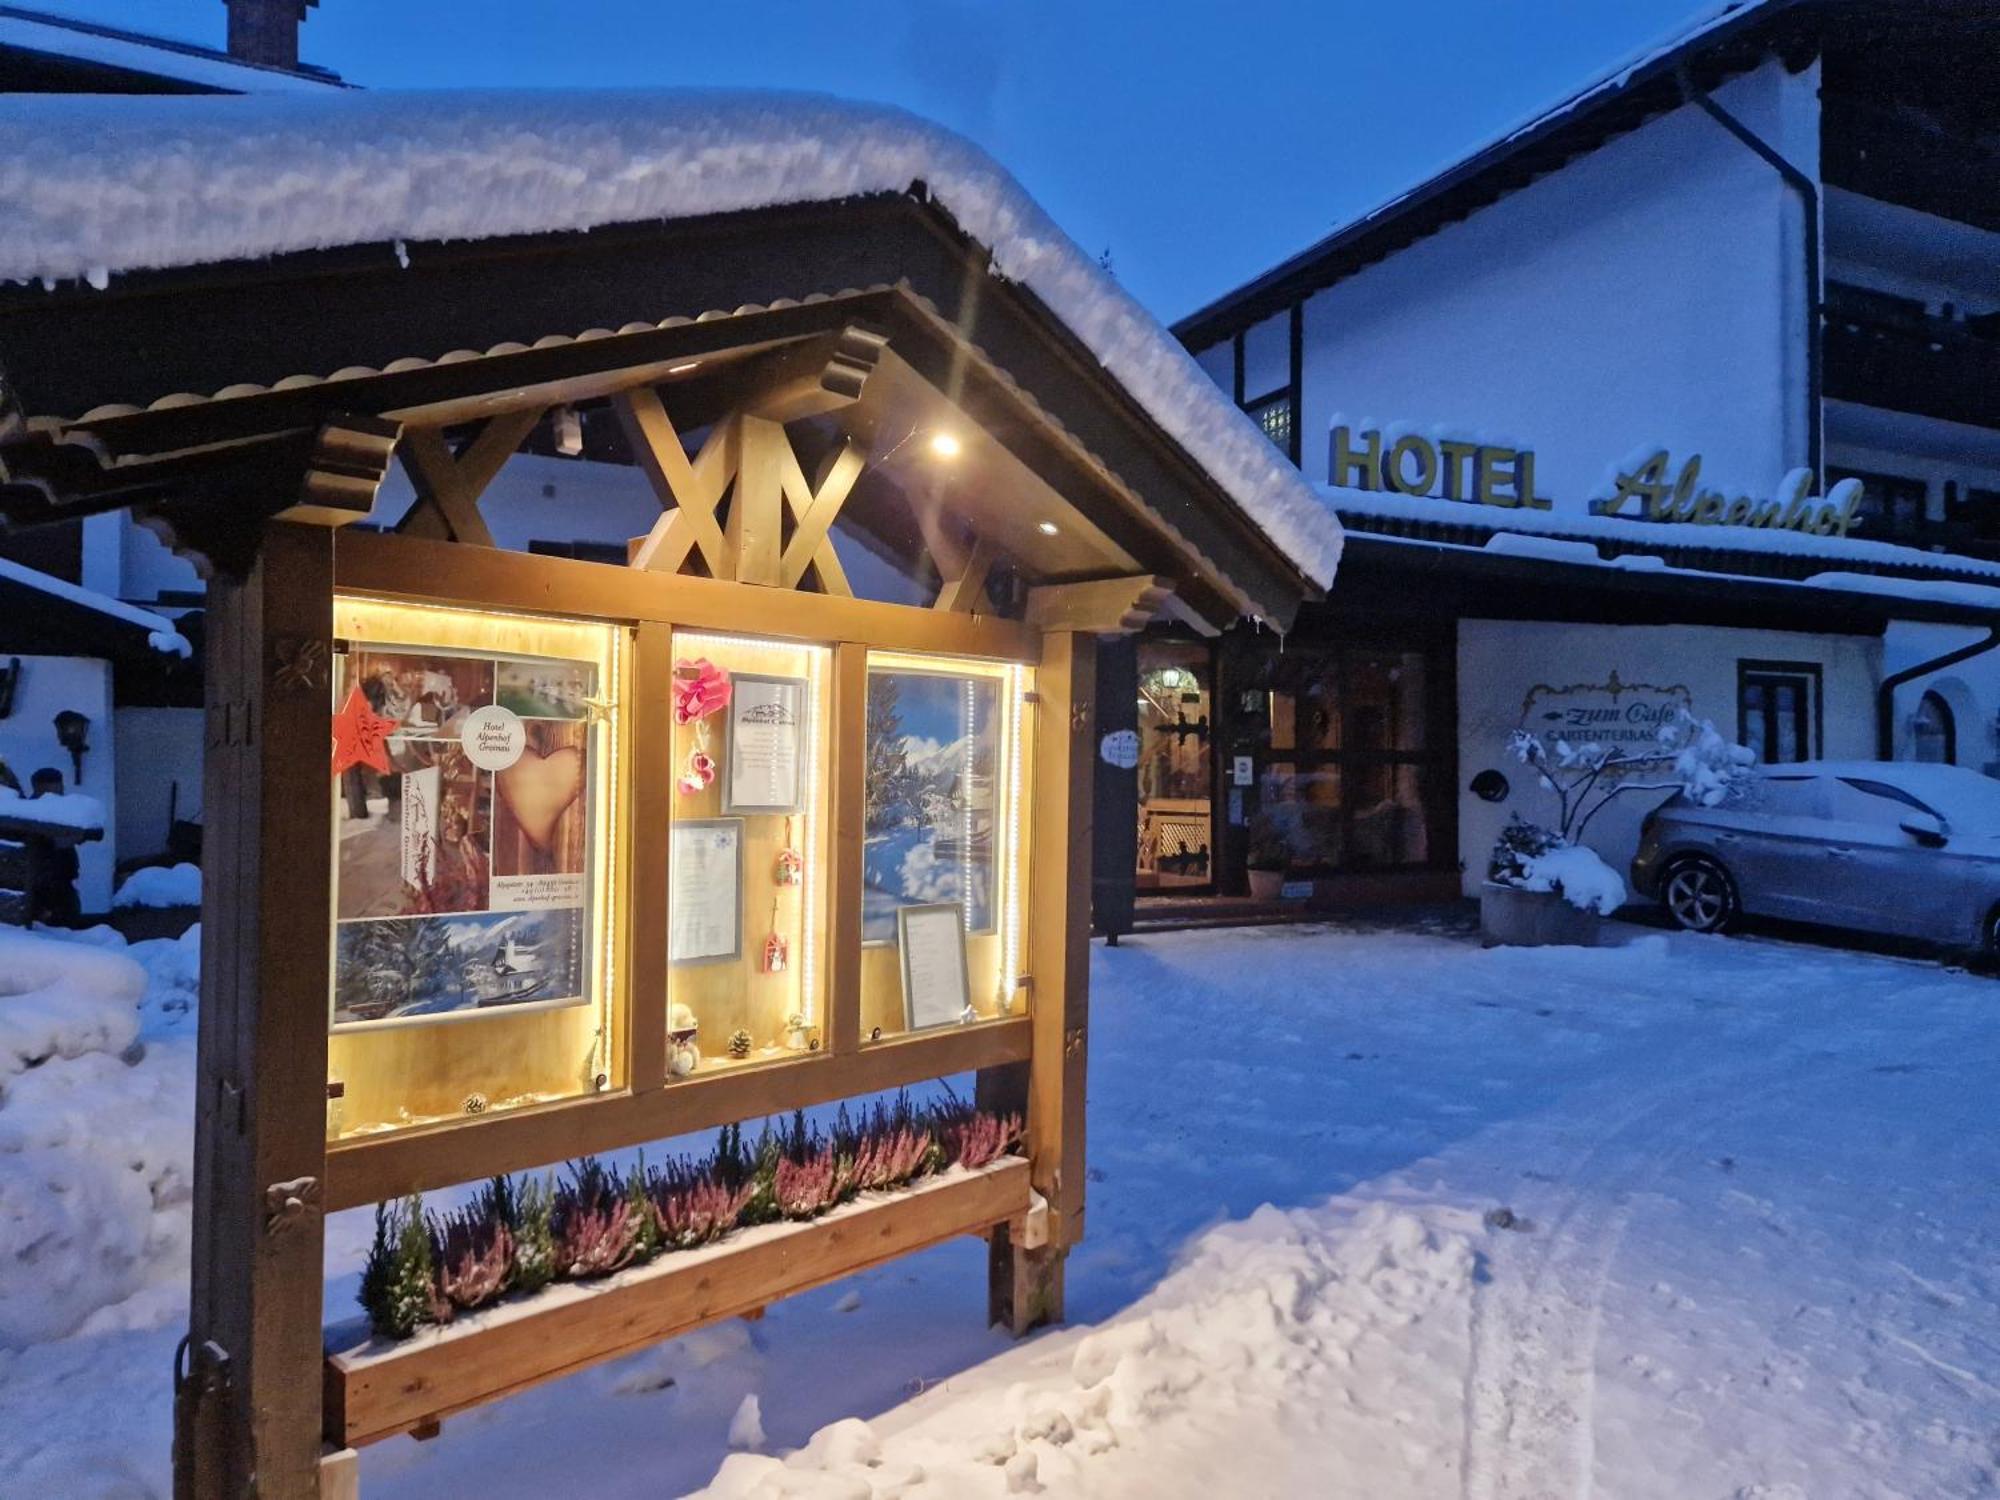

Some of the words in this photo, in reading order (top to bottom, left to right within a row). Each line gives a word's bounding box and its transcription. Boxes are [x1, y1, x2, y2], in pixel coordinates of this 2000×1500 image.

[1328, 424, 1553, 511] HOTEL
[1588, 449, 1864, 537] Alpenhof
[483, 721, 505, 732] Hotel
[1566, 708, 1621, 727] Zum
